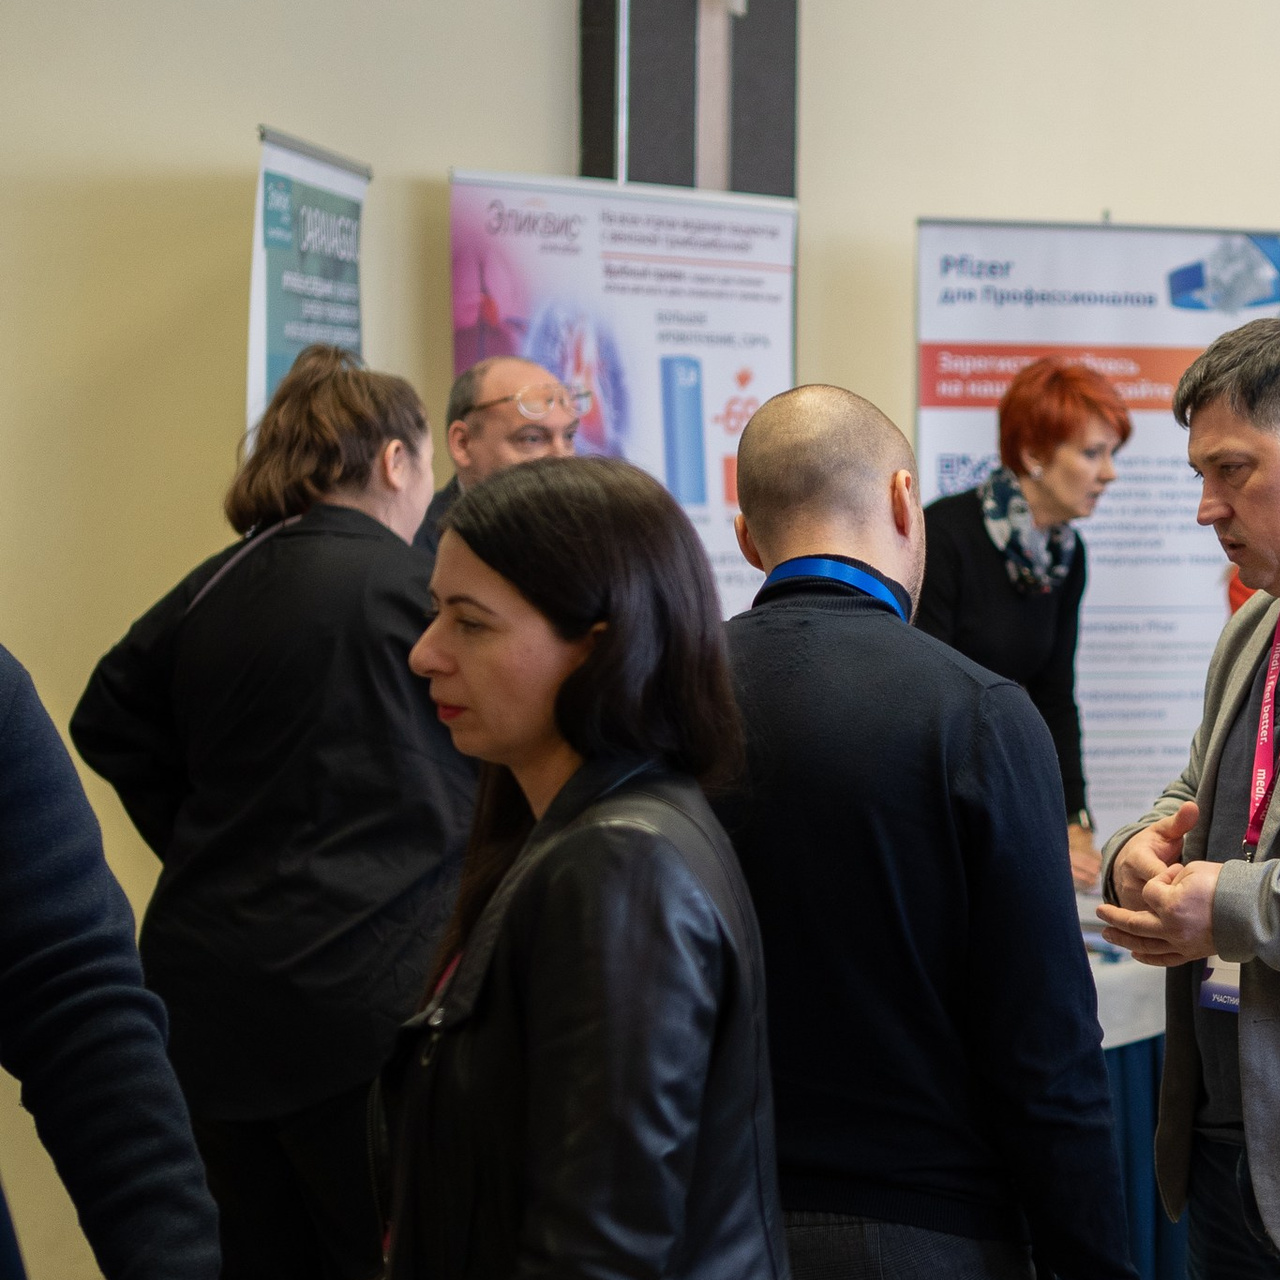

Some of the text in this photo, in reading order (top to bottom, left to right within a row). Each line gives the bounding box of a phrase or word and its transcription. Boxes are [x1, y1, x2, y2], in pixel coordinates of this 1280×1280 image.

[940, 255, 1013, 278] Pfizer
[938, 286, 1157, 308] для Профессионалов
[1259, 704, 1273, 746] better.
